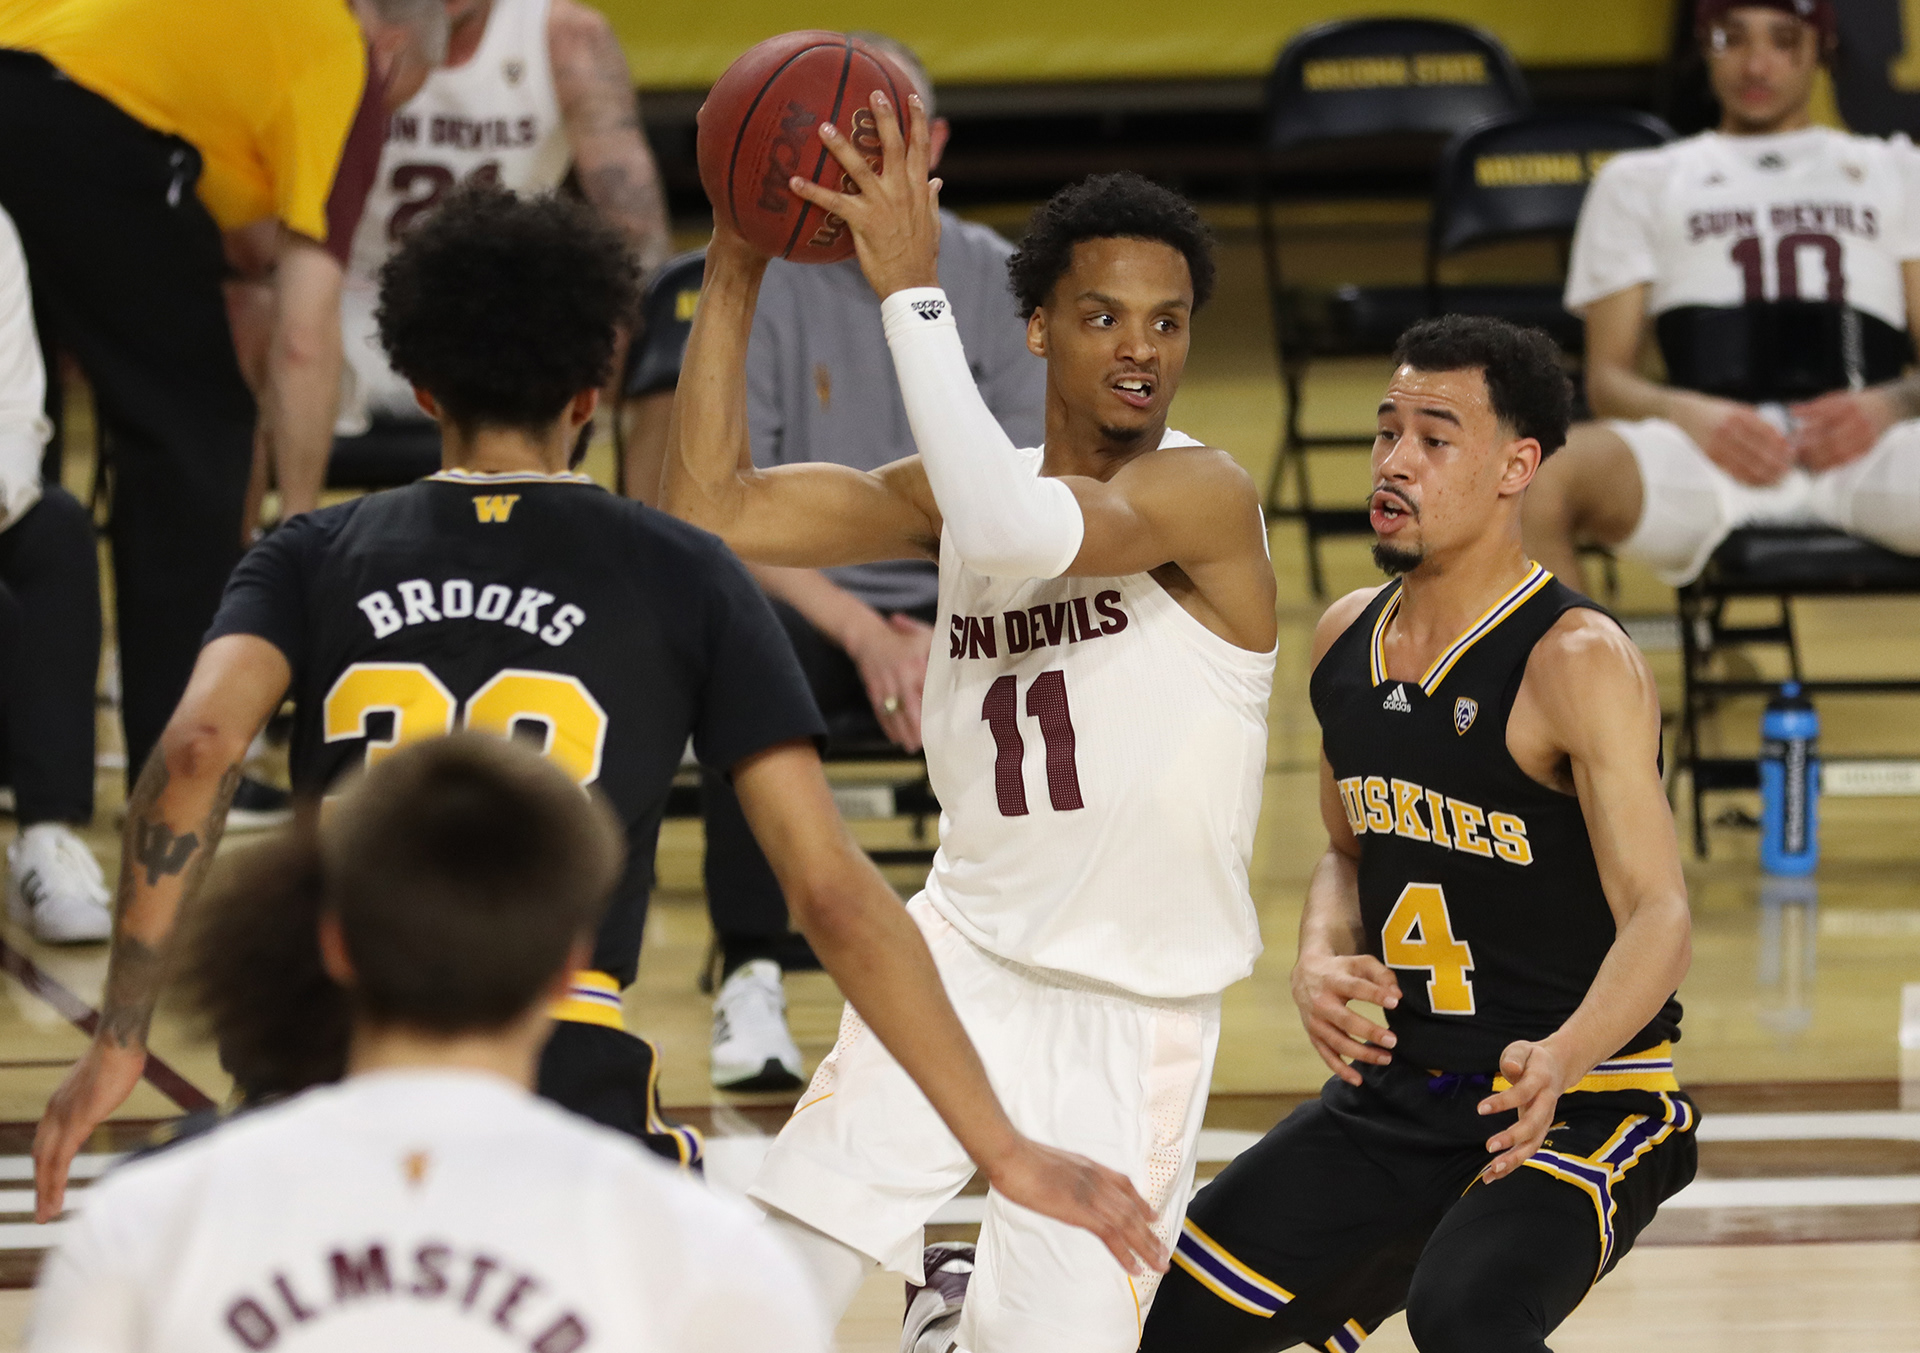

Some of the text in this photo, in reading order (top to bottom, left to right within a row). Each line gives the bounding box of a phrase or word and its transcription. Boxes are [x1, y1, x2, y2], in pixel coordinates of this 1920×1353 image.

[1731, 232, 1844, 305] 10
[910, 300, 946, 312] adidas
[471, 493, 522, 523] W
[357, 578, 586, 646] BROOKS
[1003, 588, 1129, 655] DEVILS
[1382, 700, 1412, 714] adidas
[981, 669, 1085, 817] 11
[1336, 775, 1534, 867] USKIES
[1381, 881, 1476, 1016] 4
[225, 1240, 590, 1353] OLMSTED
